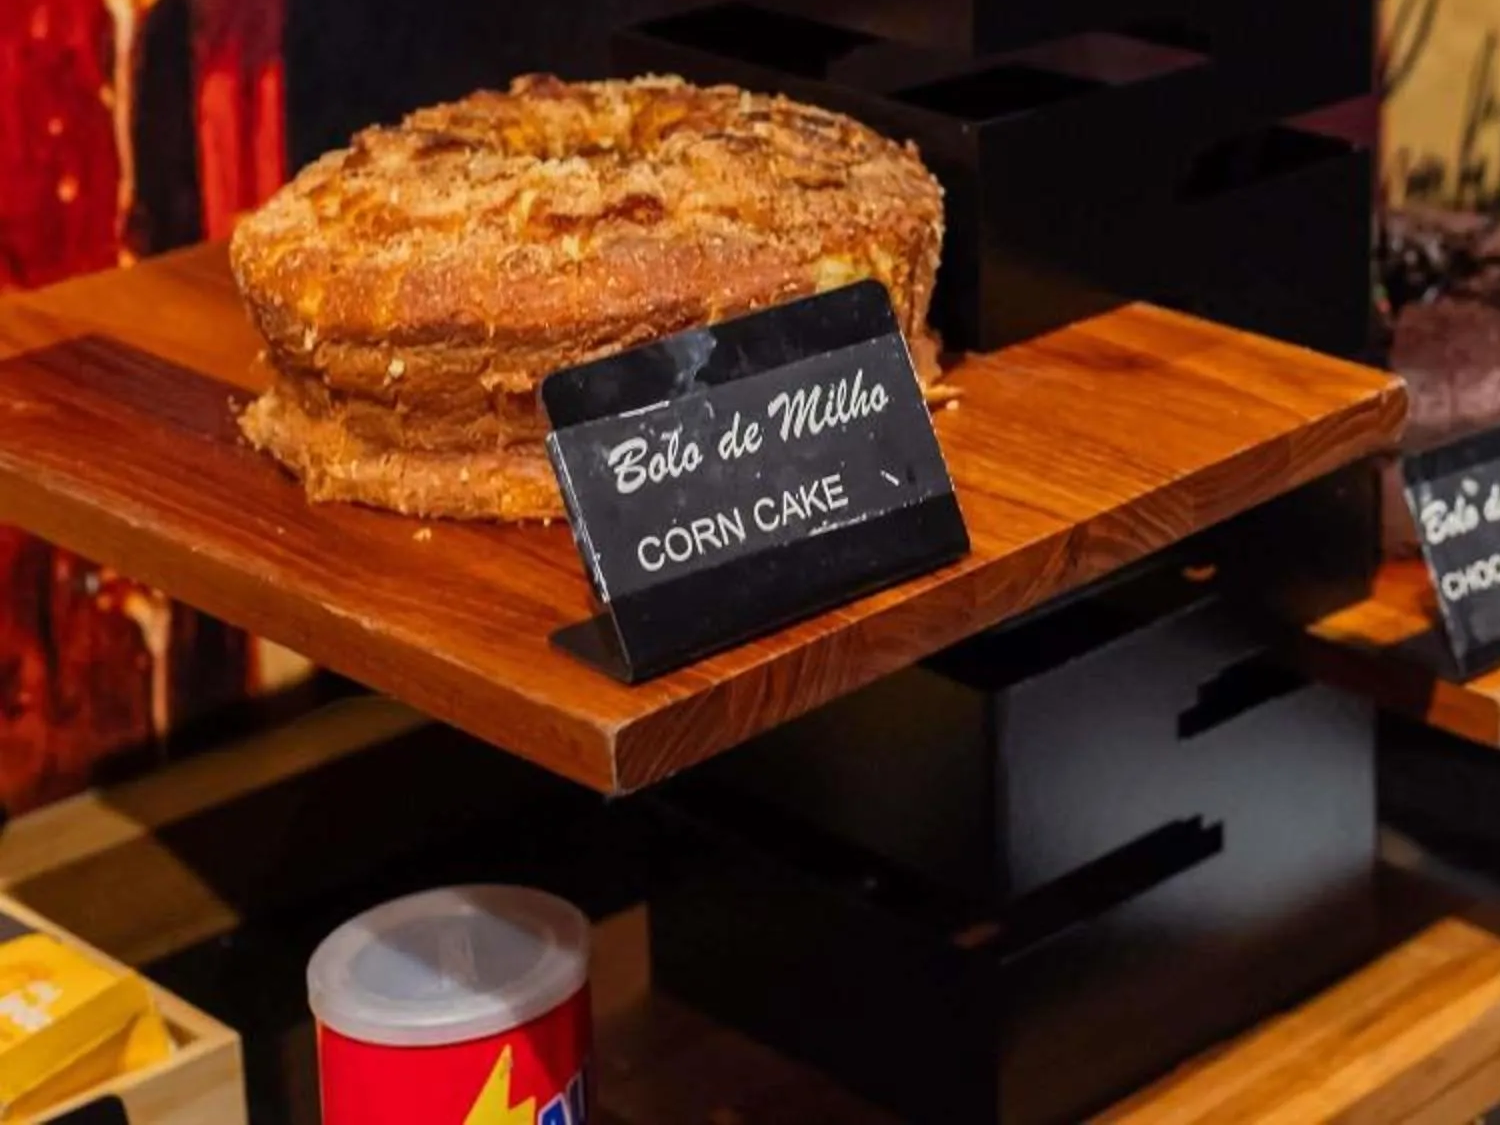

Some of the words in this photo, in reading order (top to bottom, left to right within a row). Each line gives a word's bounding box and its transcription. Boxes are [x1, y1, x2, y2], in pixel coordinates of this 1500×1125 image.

[607, 430, 704, 495] Bolo
[718, 411, 764, 461] de
[767, 369, 889, 443] Milho
[637, 507, 747, 573] CORN
[753, 474, 850, 533] CAKE
[1420, 494, 1480, 545] Bolo
